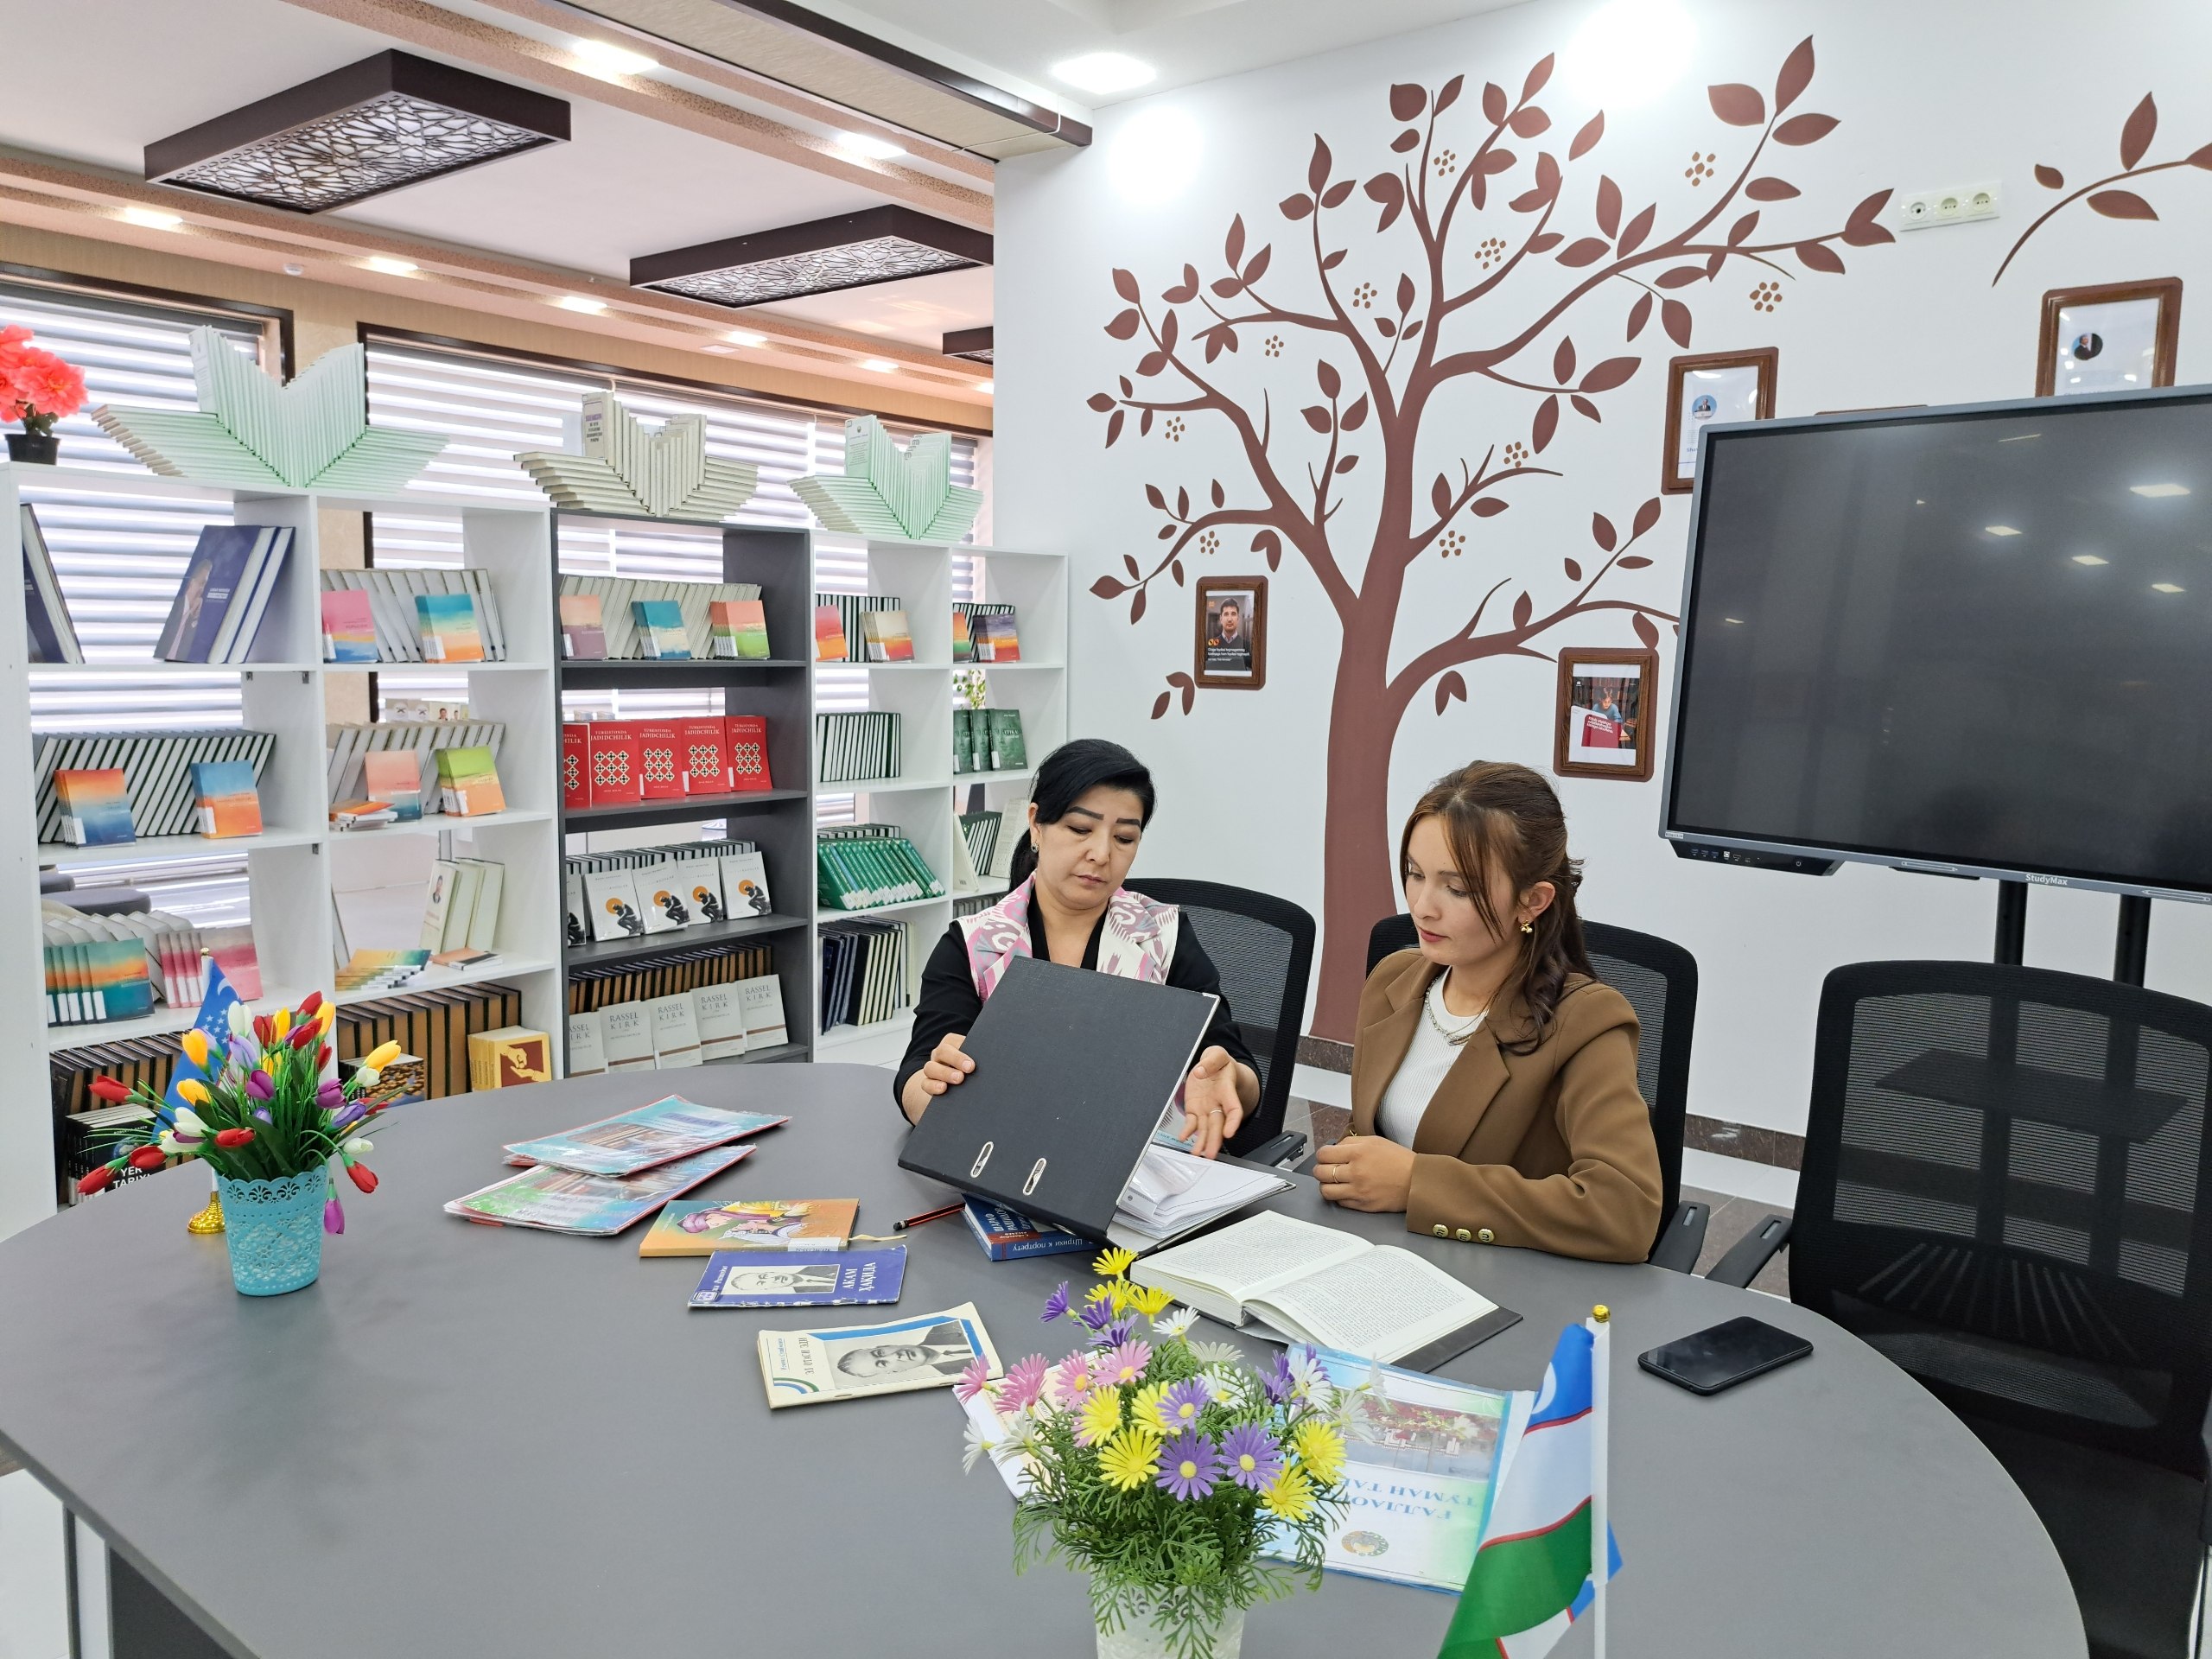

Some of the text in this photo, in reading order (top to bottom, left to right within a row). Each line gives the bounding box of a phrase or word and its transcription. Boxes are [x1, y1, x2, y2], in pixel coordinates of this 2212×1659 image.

[2025, 874, 2068, 886] StudyMax
[701, 994, 728, 1003] RASSEL
[658, 1003, 683, 1014] RASSEL
[609, 1012, 639, 1022] RASSEL
[610, 1020, 639, 1030] KIRK
[1013, 1241, 1046, 1252] портрету
[1055, 1238, 1083, 1247] Штрихи
[842, 1268, 858, 1289] АКАМ
[801, 1349, 811, 1366] ОТАСИ
[1390, 1485, 1478, 1507] ТУМАН
